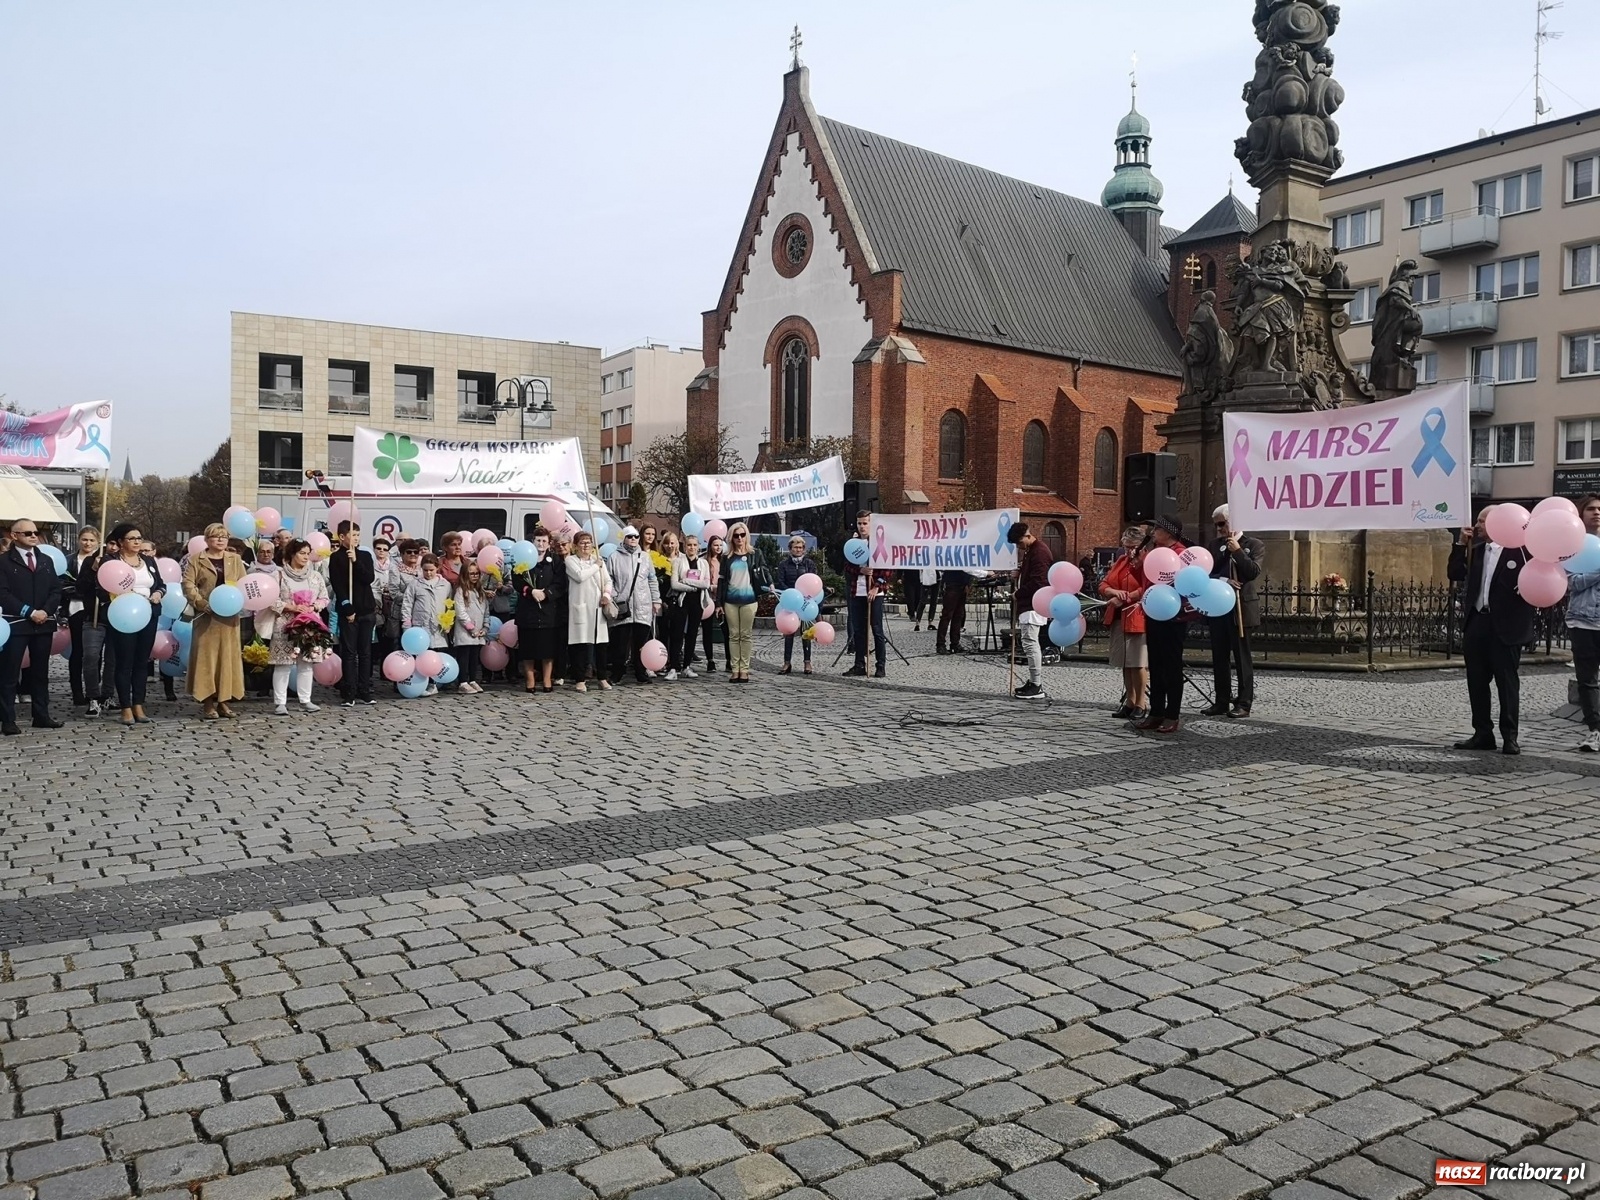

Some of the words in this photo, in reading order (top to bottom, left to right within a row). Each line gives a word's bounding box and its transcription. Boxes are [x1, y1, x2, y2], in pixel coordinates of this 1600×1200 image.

[425, 437, 480, 453] GRUPA
[1266, 417, 1399, 461] MARSZ
[730, 481, 757, 493] NIGDY
[760, 479, 776, 491] NIE
[778, 474, 804, 489] MYŚL
[1254, 468, 1403, 510] NADZIEI
[709, 497, 721, 512] ŻE
[723, 499, 753, 512] CIEBIE
[757, 498, 768, 509] TO
[770, 494, 786, 507] NIE
[789, 485, 830, 504] DOTYCZY
[381, 523, 394, 541] R
[913, 513, 968, 543] ZDĄŻYĆ
[891, 545, 930, 566] PRZED
[935, 544, 991, 567] RAKIEM
